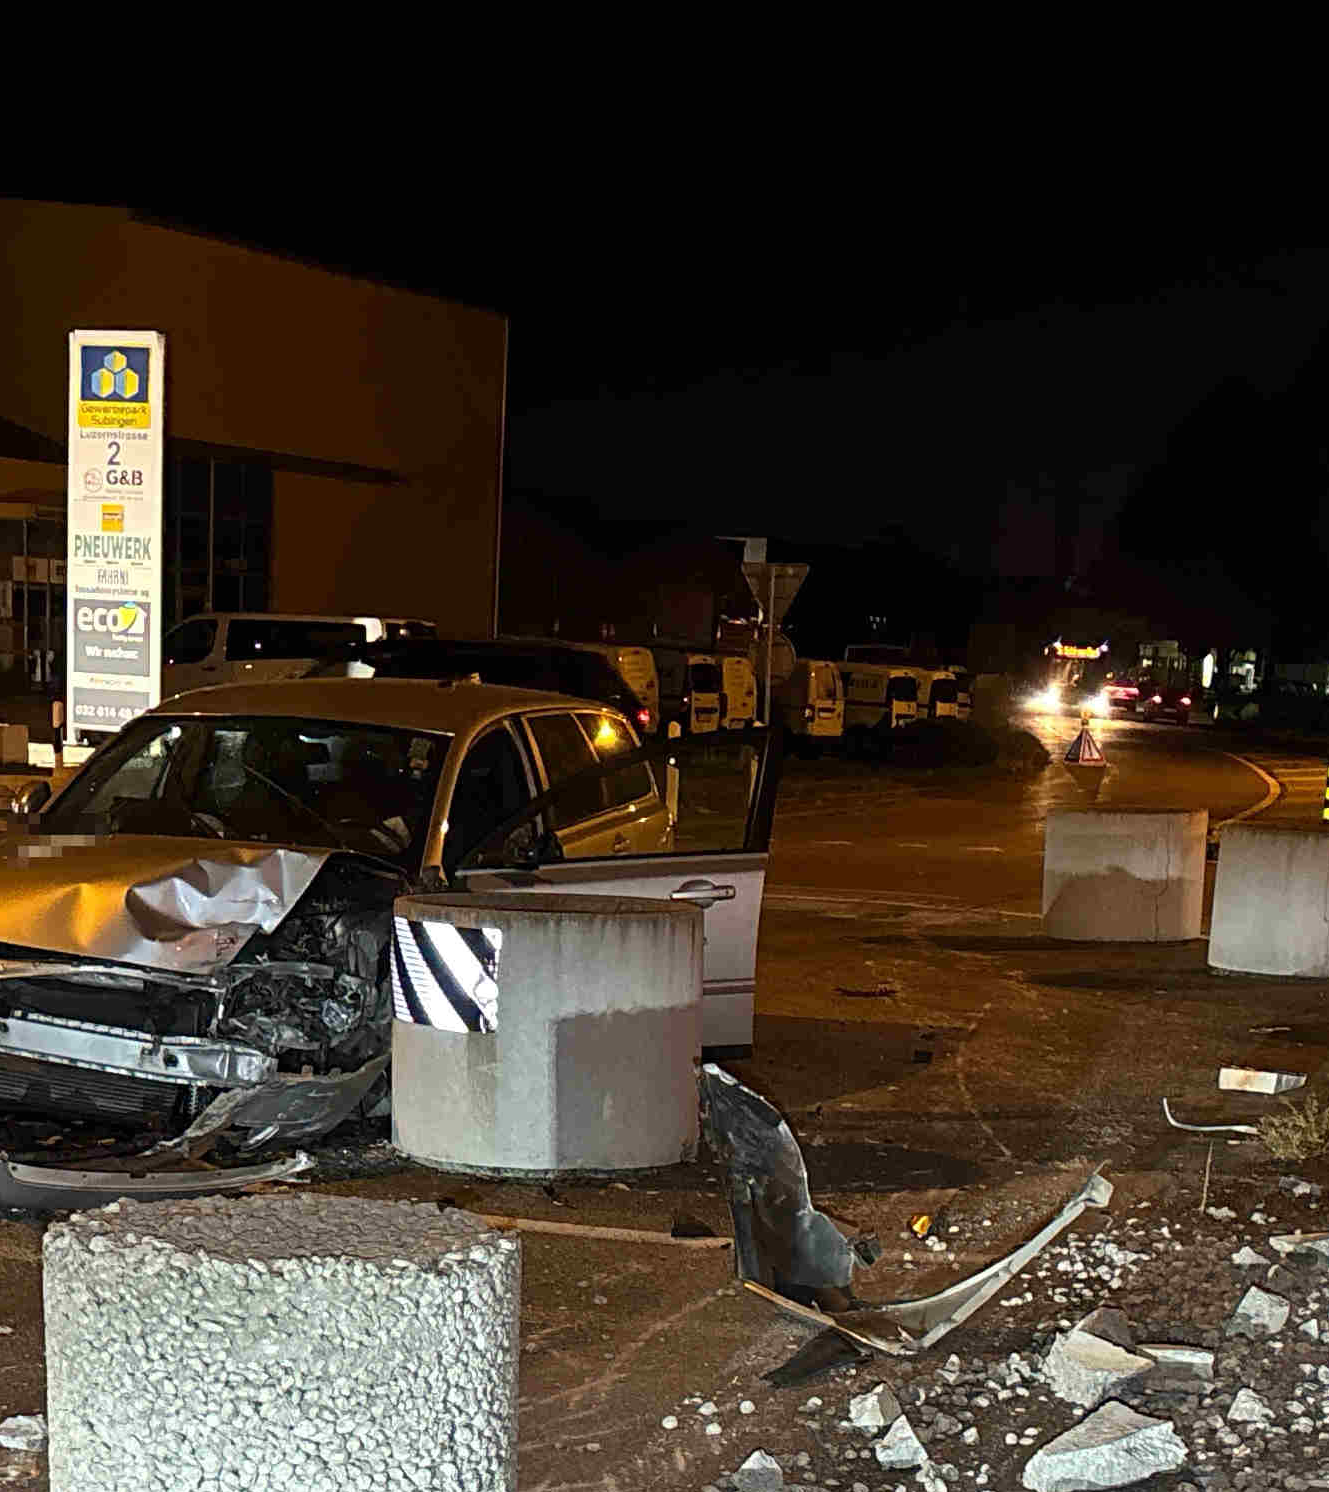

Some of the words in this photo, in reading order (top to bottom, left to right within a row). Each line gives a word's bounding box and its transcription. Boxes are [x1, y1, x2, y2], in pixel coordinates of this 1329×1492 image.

[107, 441, 121, 466] 2
[106, 469, 143, 486] G&B
[74, 534, 151, 561] PNEUWERK
